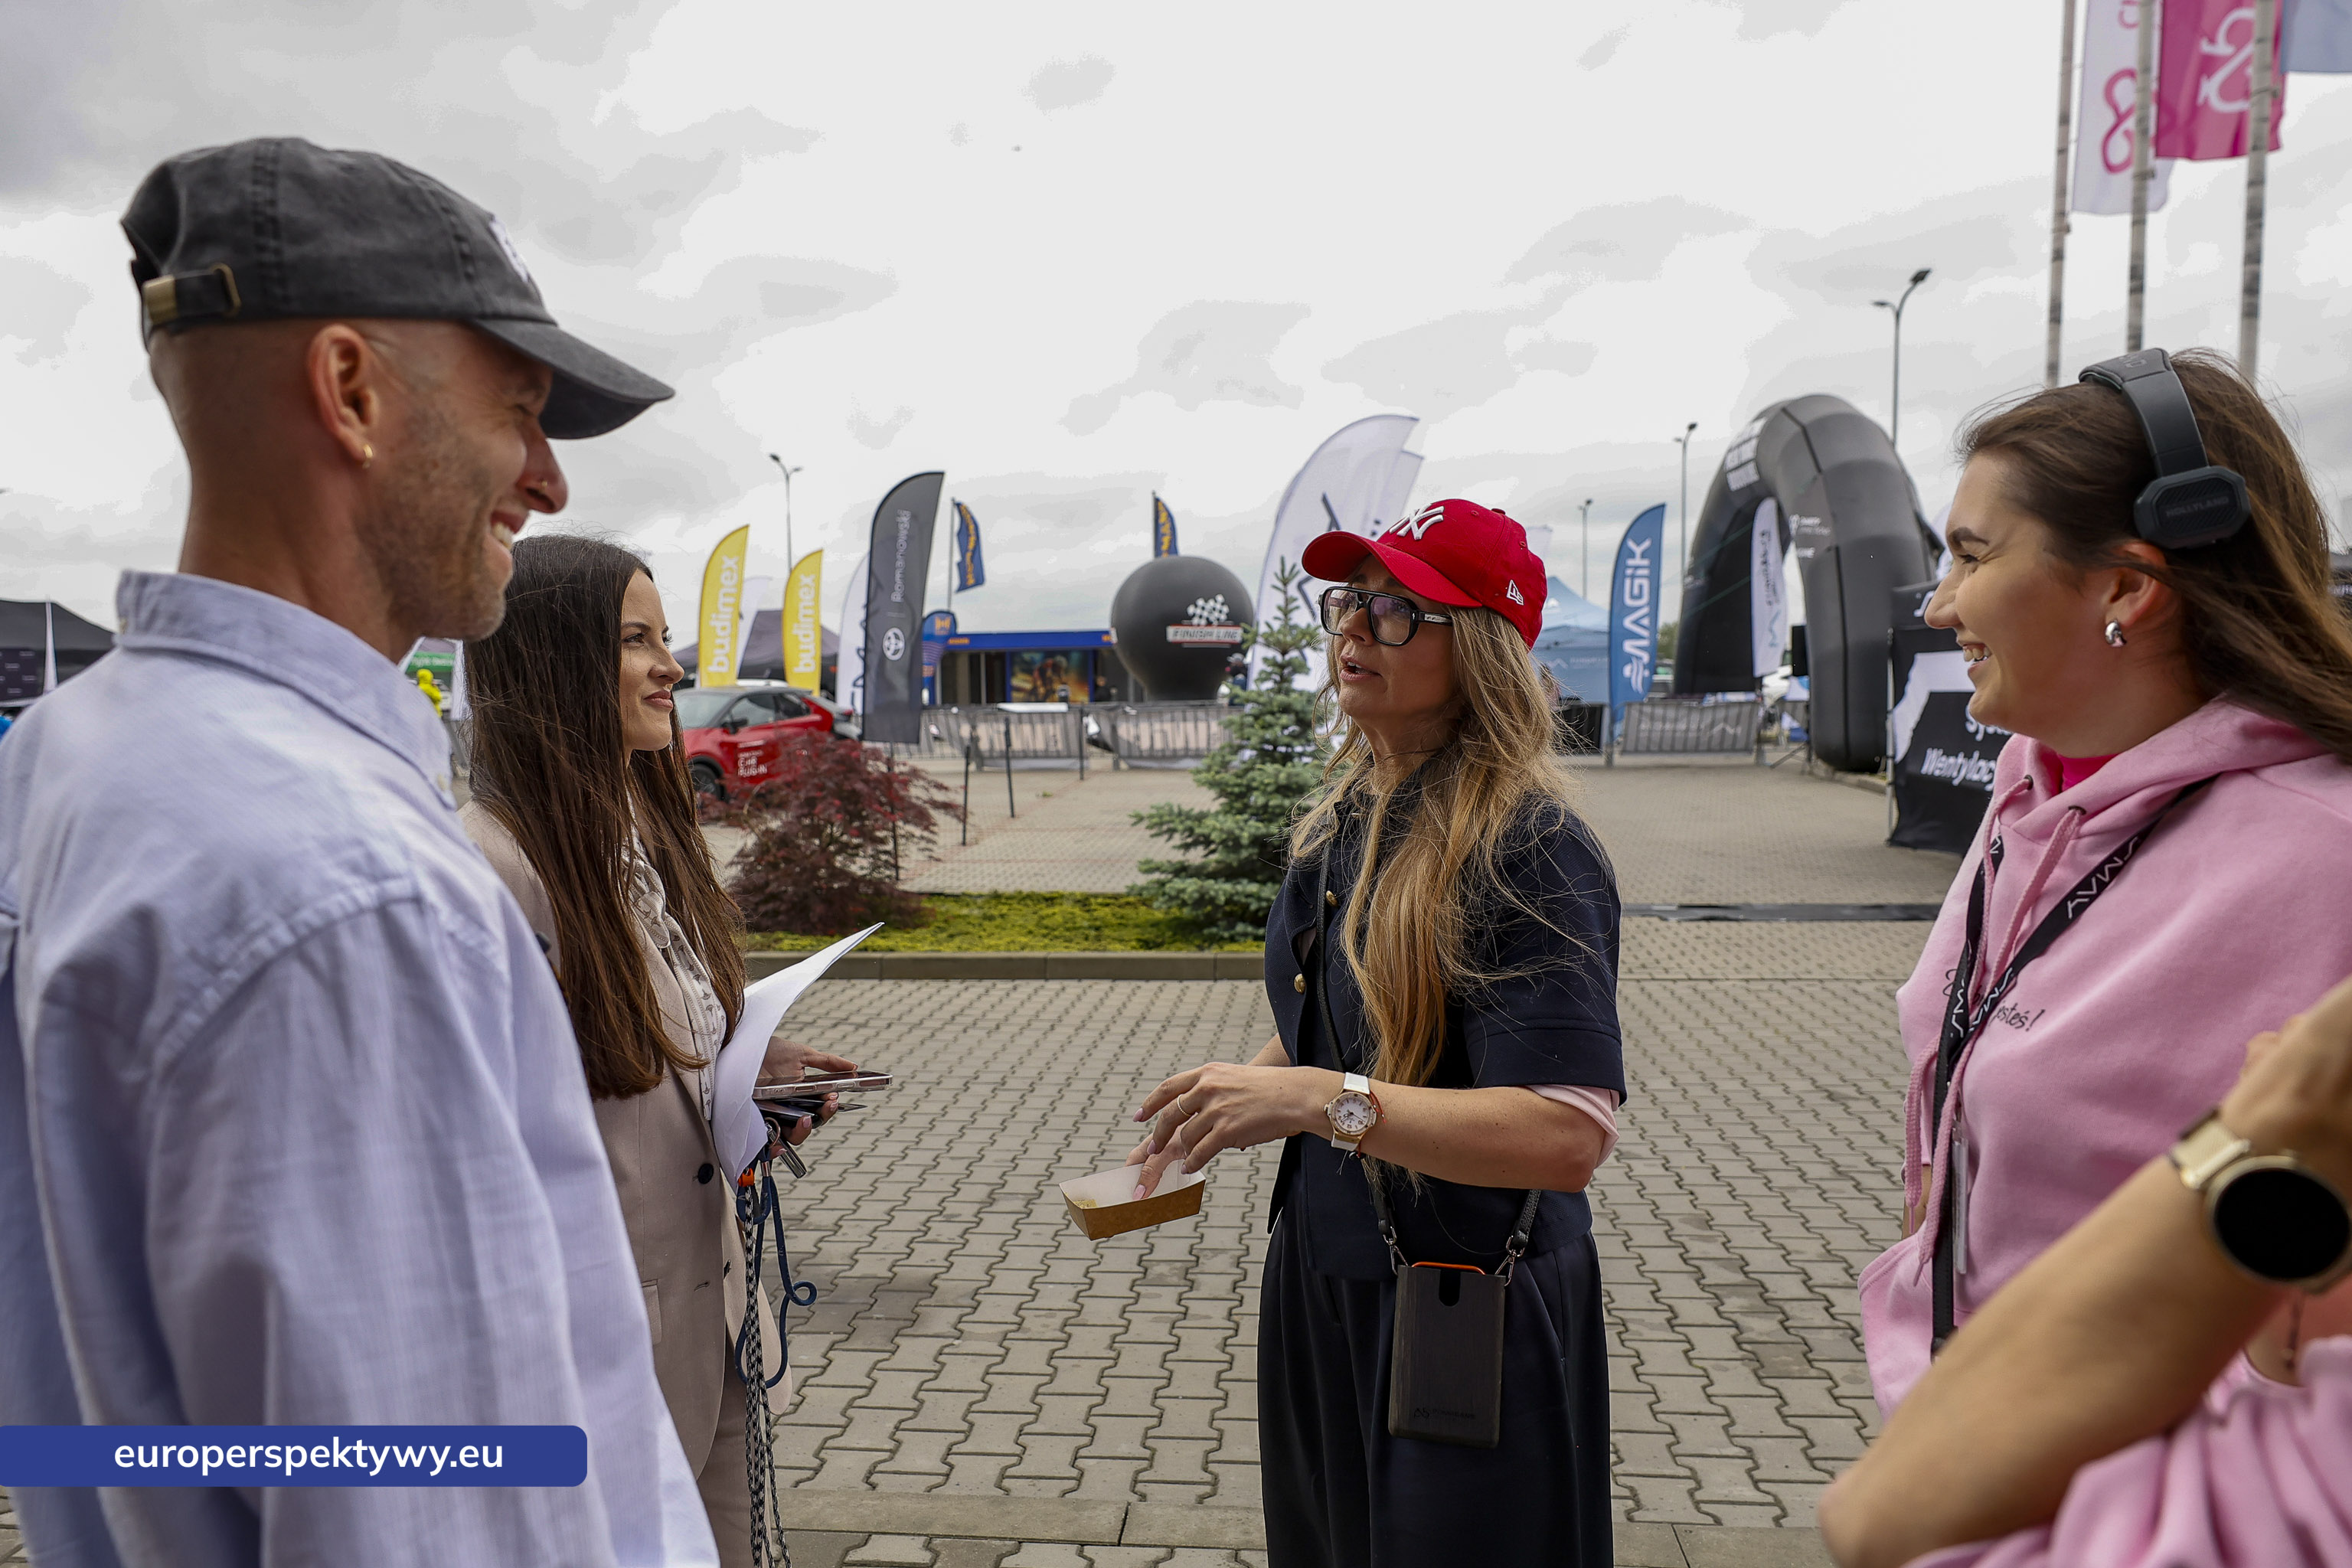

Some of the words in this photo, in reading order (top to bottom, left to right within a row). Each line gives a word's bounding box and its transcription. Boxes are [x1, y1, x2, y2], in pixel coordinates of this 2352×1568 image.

[2164, 495, 2230, 518] HOLLYLAND
[890, 509, 912, 603] Romanowski
[708, 556, 740, 673] budimex
[793, 573, 816, 673] budimex
[1172, 629, 1212, 640] FINISH
[1215, 630, 1238, 640] LINE
